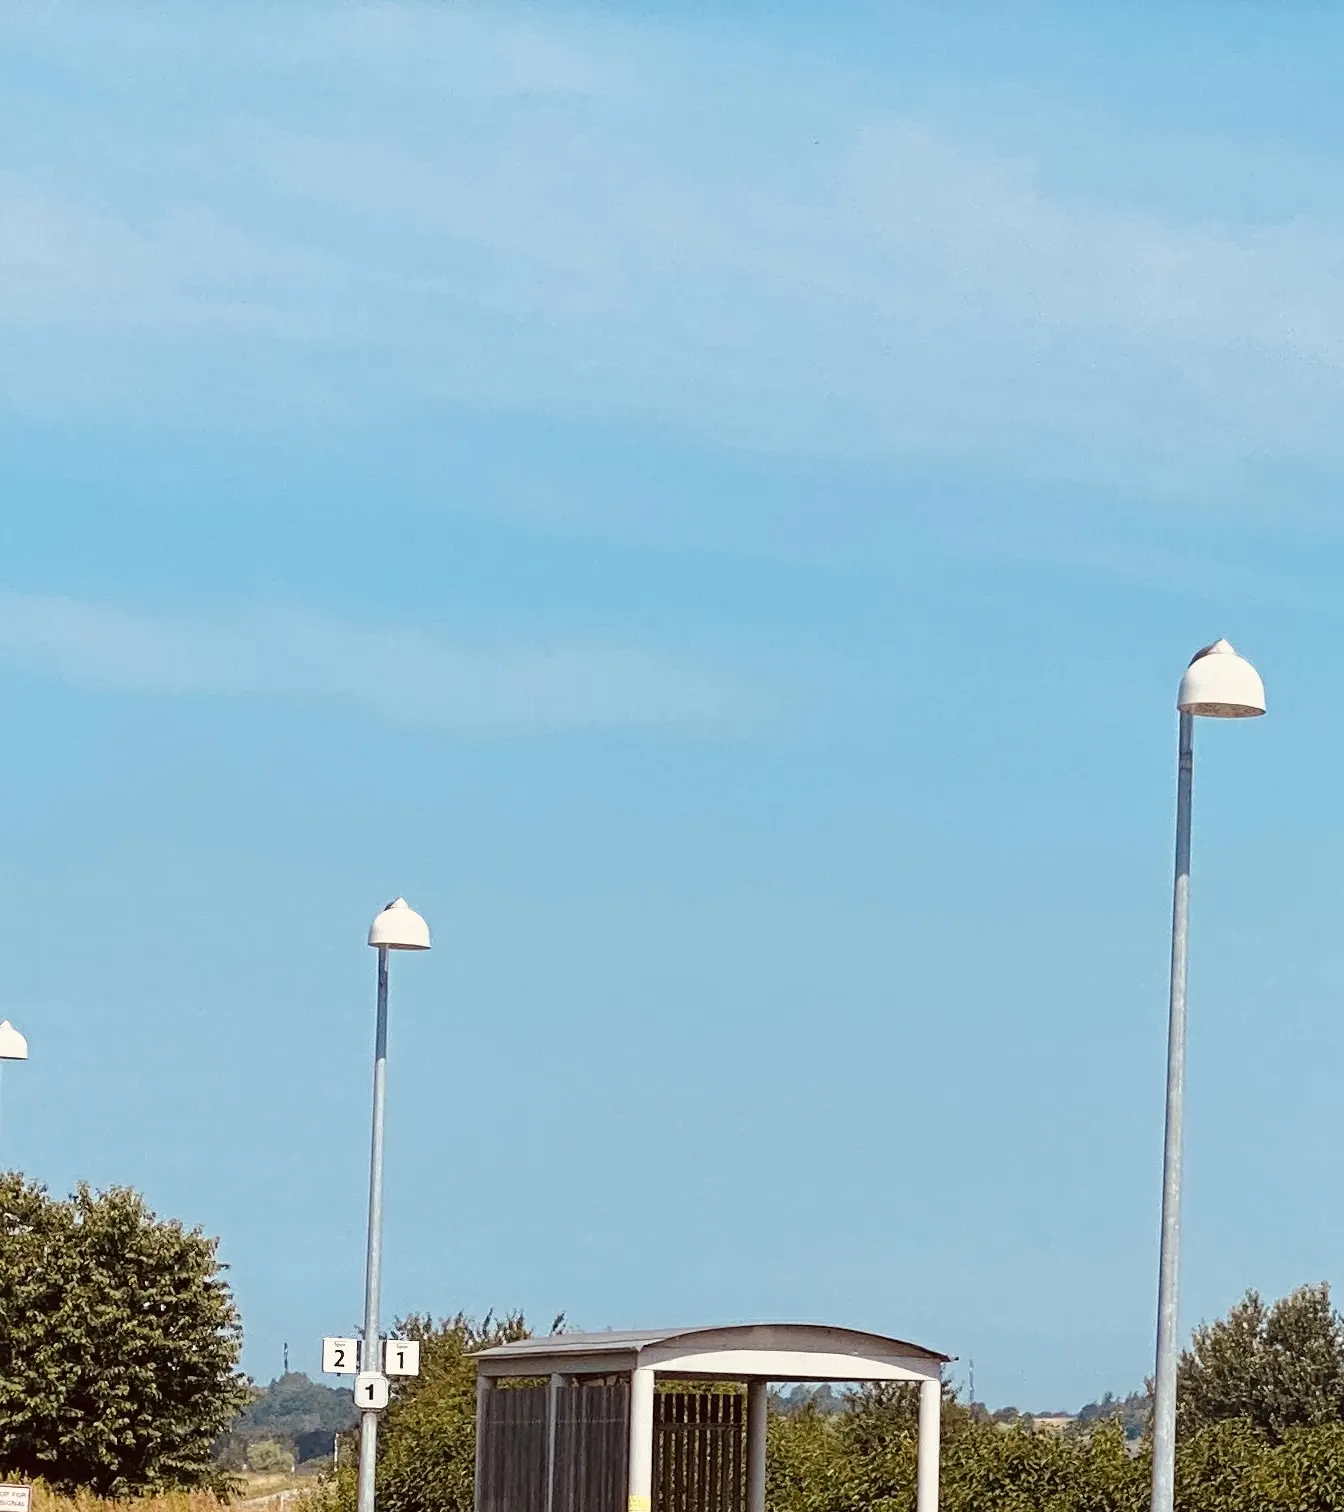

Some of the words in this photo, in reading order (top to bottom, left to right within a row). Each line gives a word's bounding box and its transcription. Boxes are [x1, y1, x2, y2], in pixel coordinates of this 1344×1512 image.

[334, 1349, 345, 1368] 2
[396, 1351, 404, 1370] 1
[364, 1383, 374, 1401] 1
